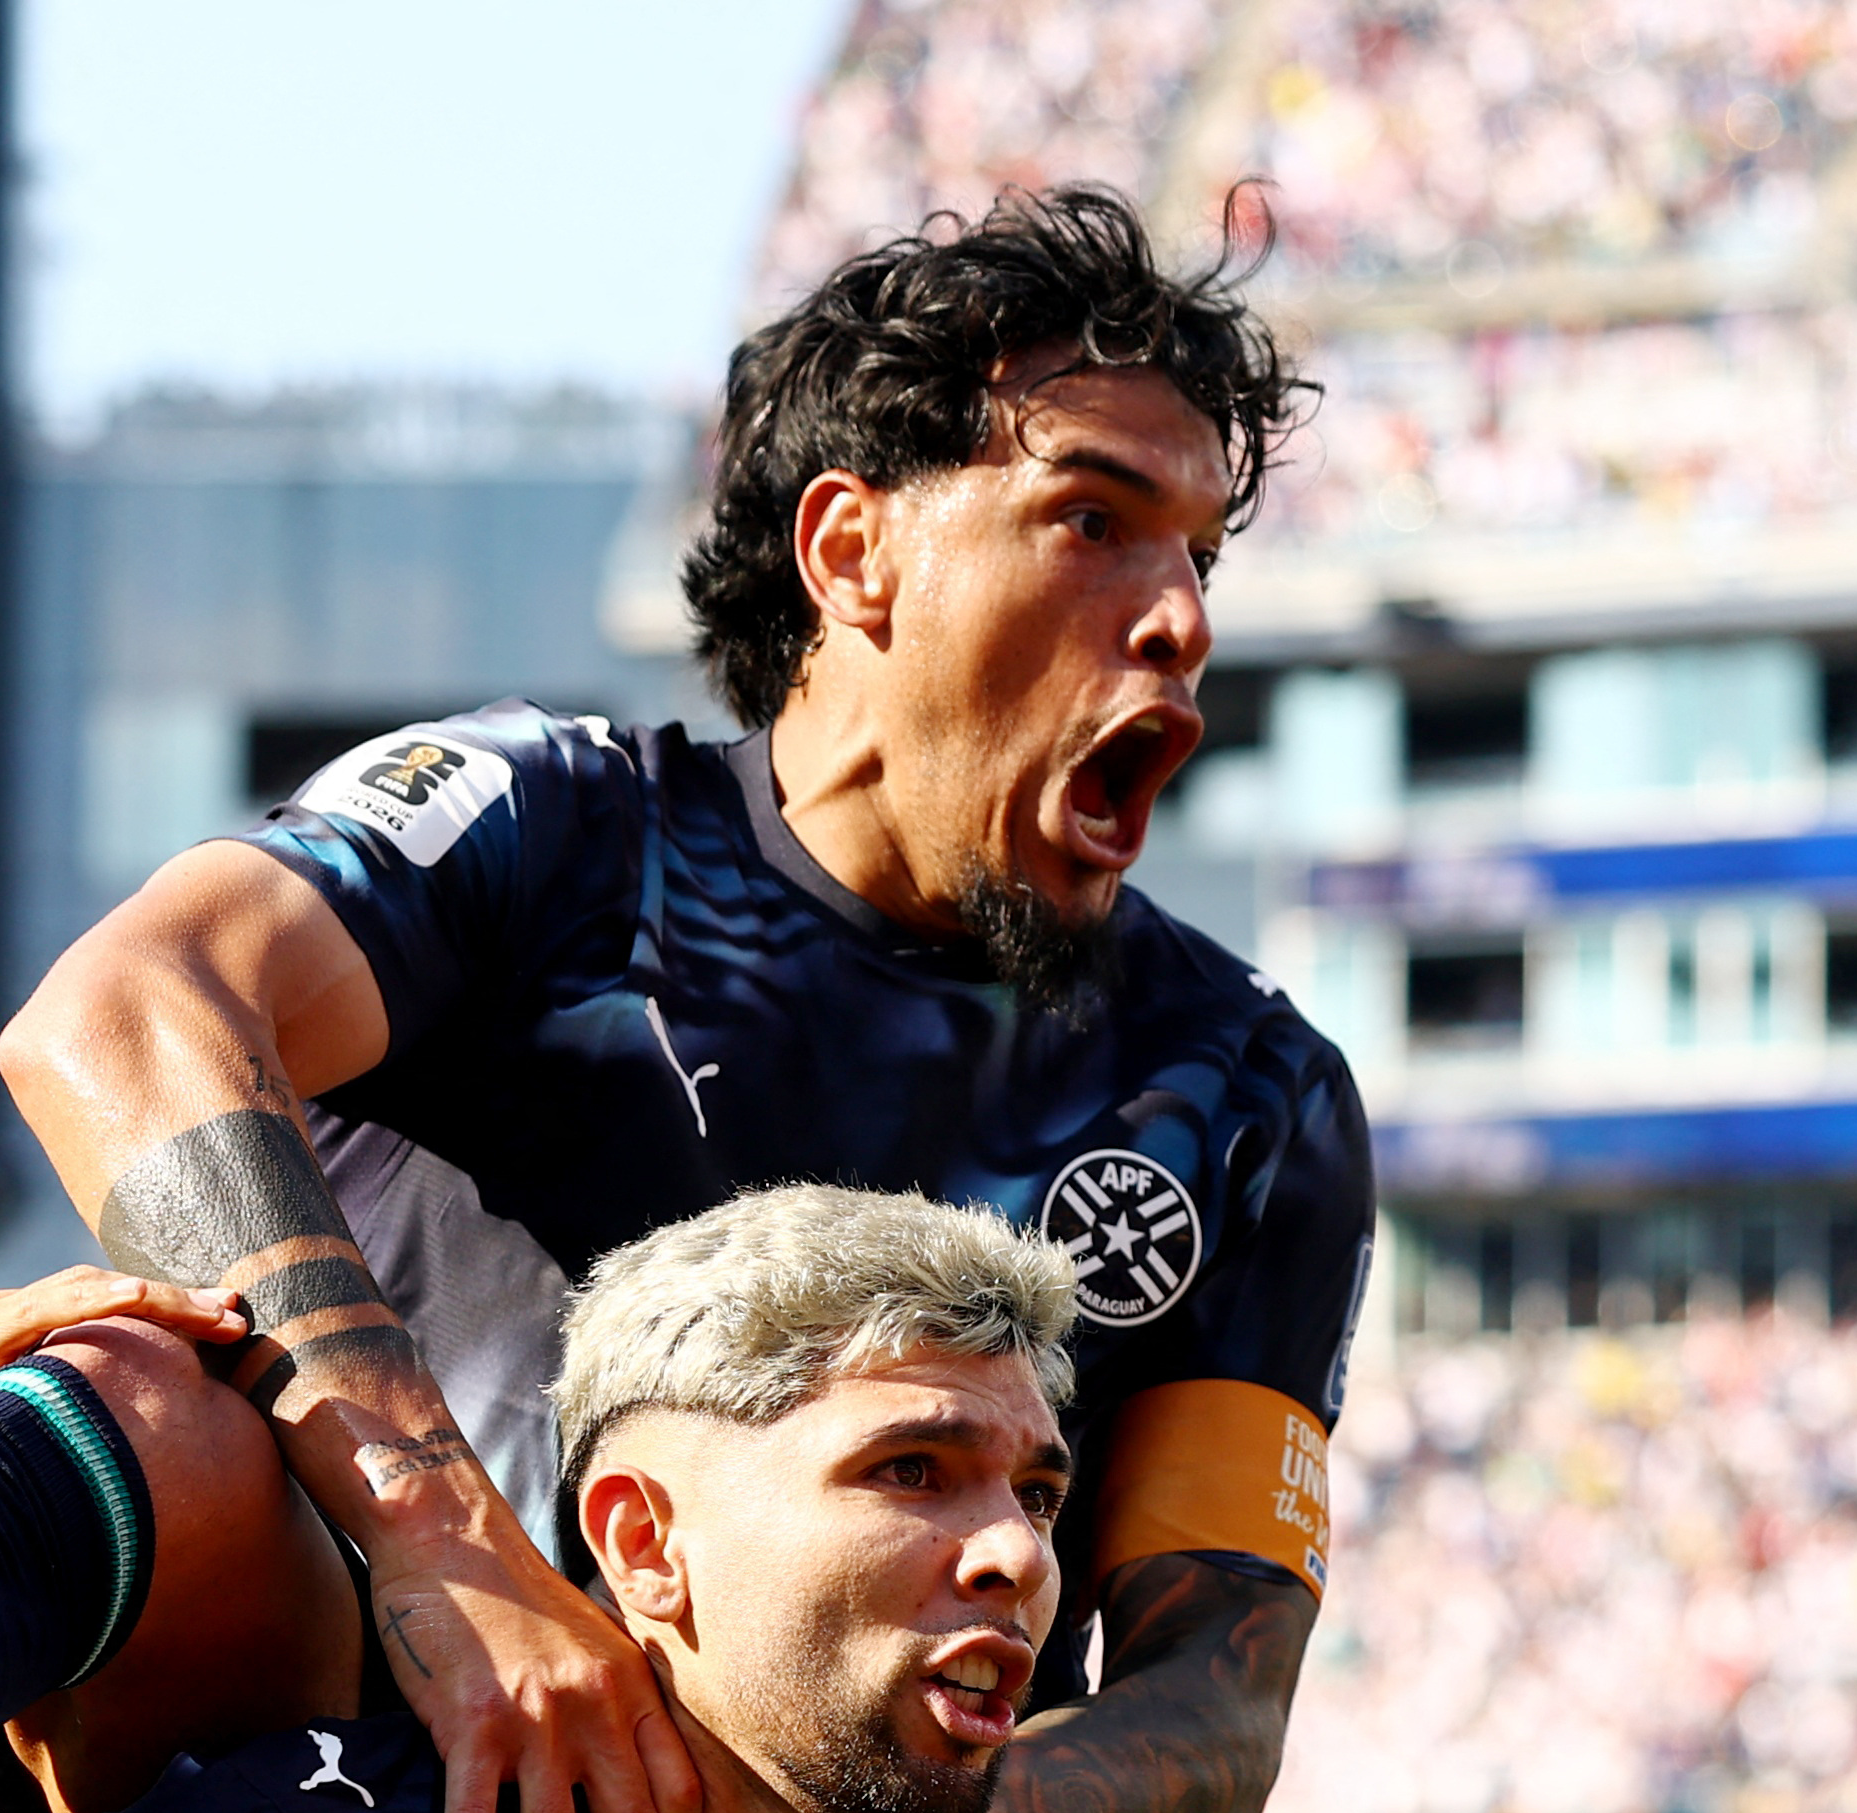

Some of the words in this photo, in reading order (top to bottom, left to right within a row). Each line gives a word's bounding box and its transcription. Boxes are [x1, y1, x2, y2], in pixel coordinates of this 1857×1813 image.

[374, 774, 410, 798] FIFA
[337, 795, 407, 832] 2026
[390, 804, 414, 820] CUP
[1099, 1161, 1154, 1197] APF
[1077, 1282, 1146, 1316] PARAGUAY
[1270, 1488, 1315, 1534] the
